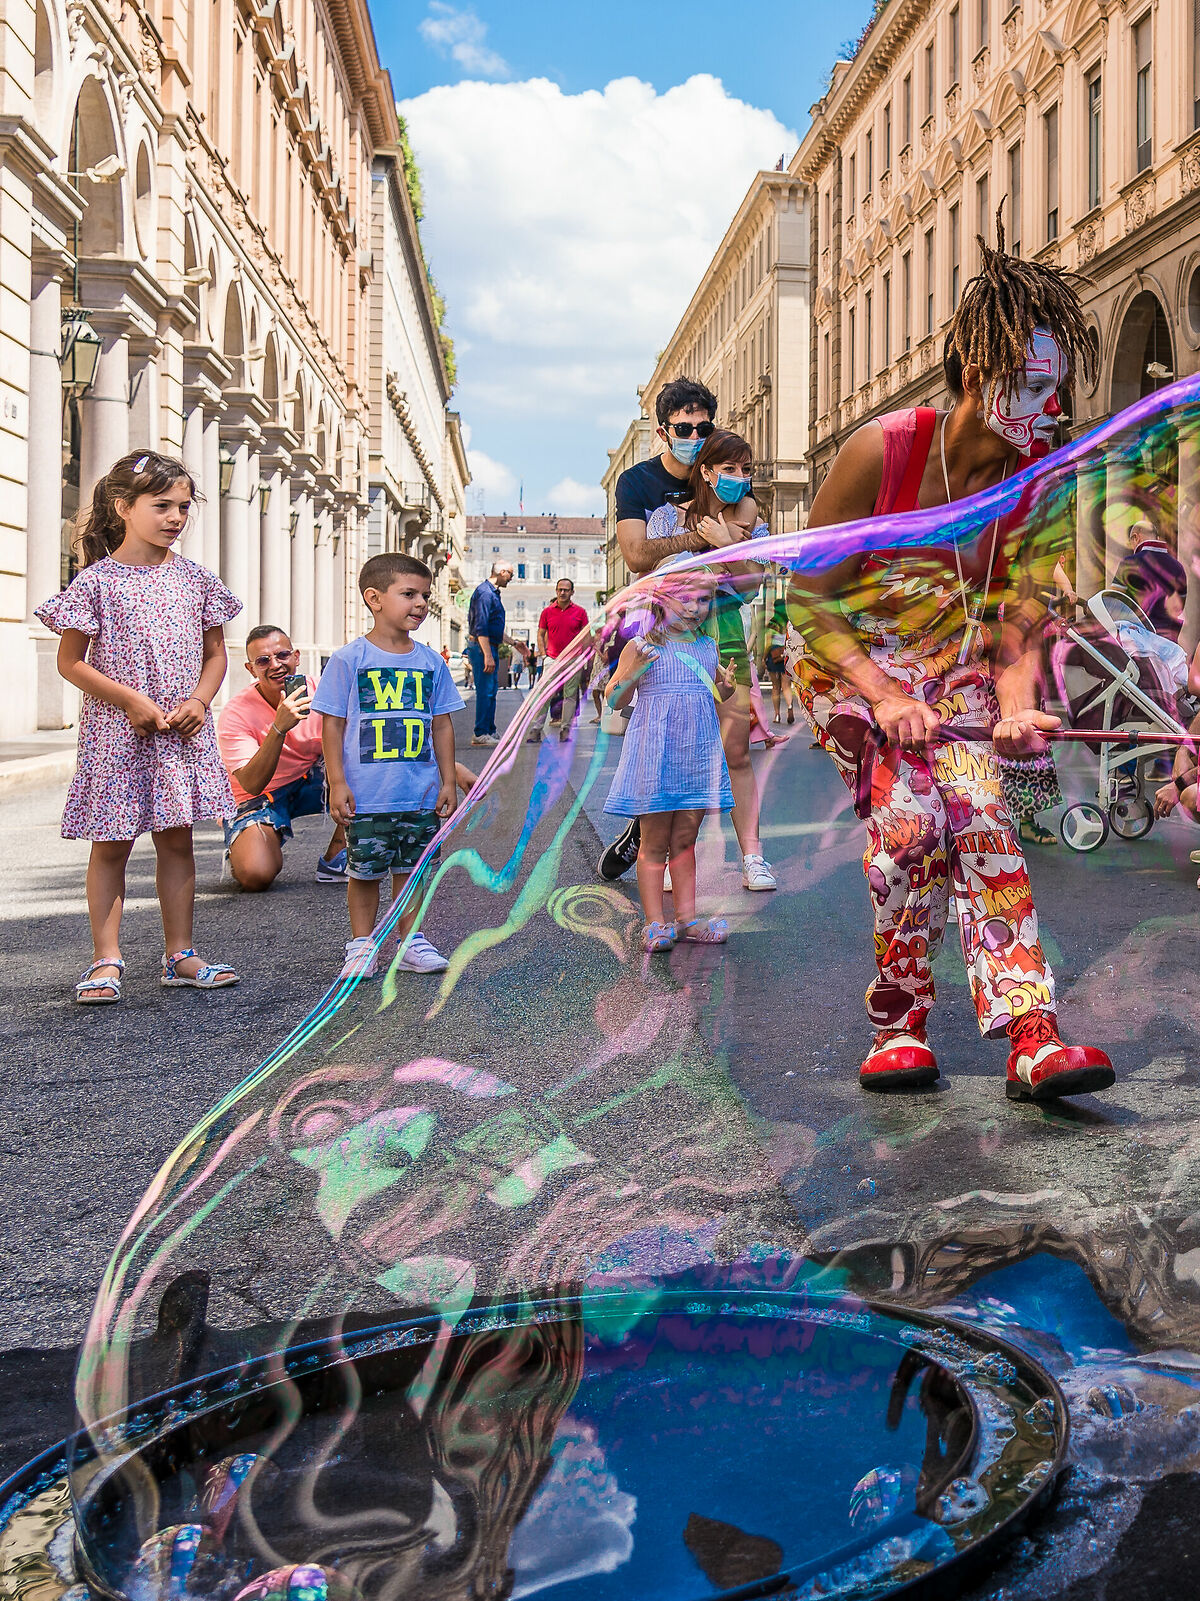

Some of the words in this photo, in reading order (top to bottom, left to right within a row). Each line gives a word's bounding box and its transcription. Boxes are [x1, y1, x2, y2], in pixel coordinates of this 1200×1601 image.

[366, 670, 425, 711] WI
[371, 718, 425, 760] LD
[980, 884, 1032, 916] KABOO
